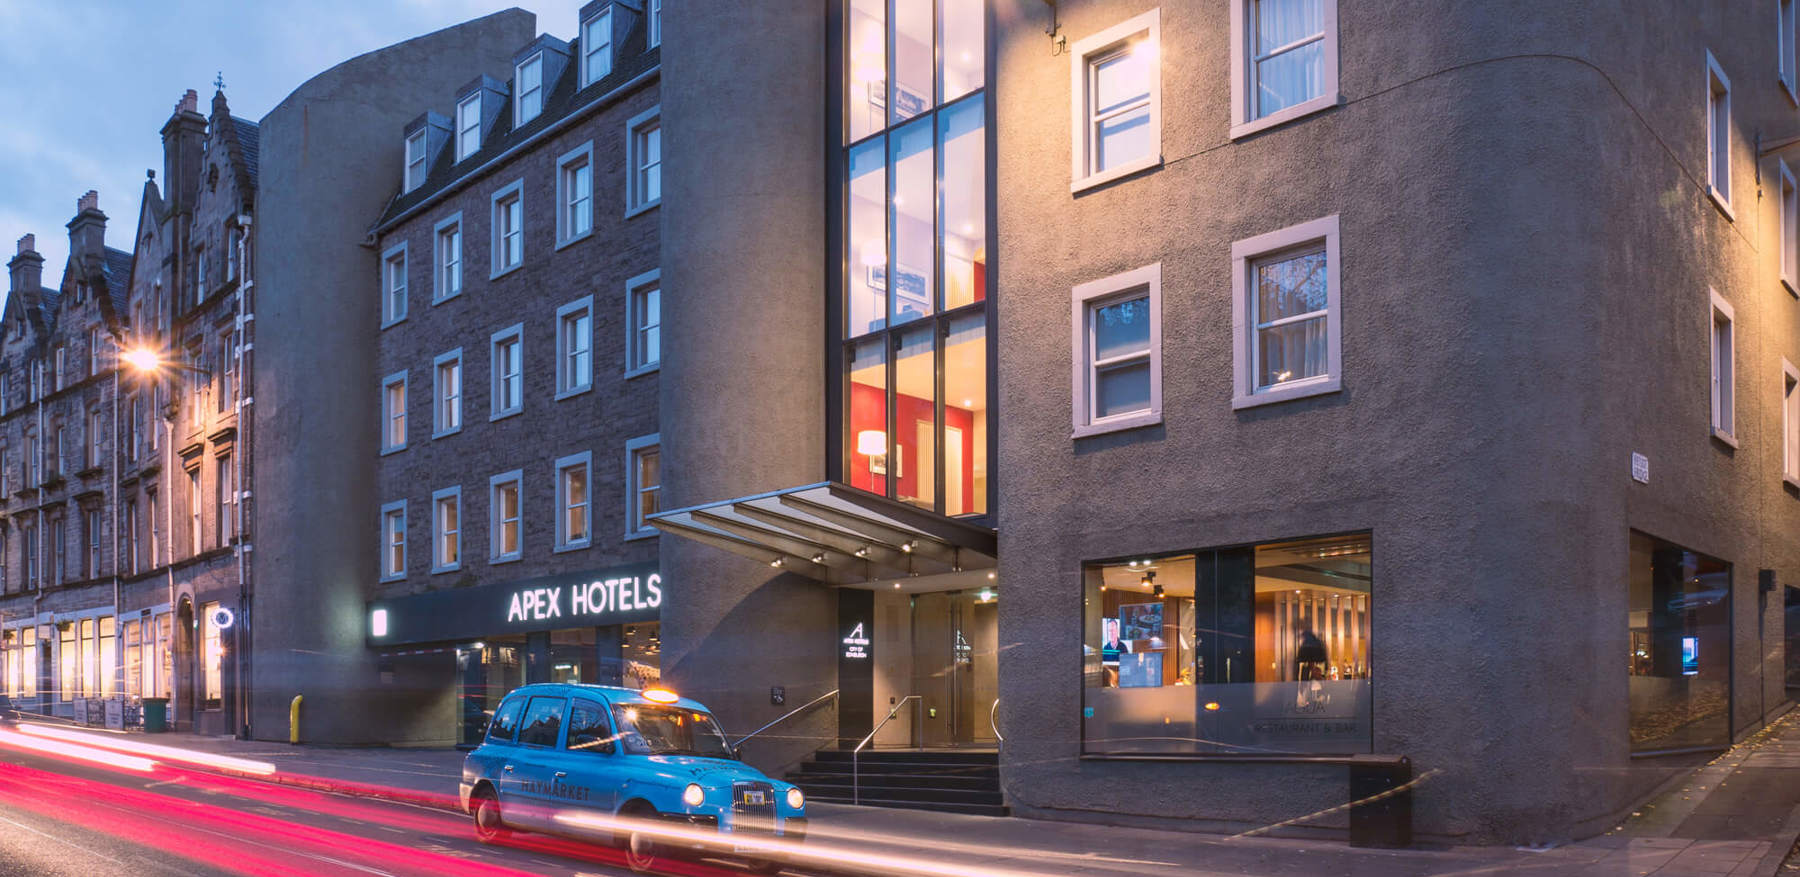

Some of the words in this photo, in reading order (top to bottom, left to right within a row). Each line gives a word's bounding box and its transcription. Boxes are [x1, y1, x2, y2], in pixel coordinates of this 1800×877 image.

[508, 587, 561, 622] APEX
[572, 573, 661, 615] HOTELS
[850, 622, 863, 639] A
[521, 779, 590, 801] HAYMARKET
